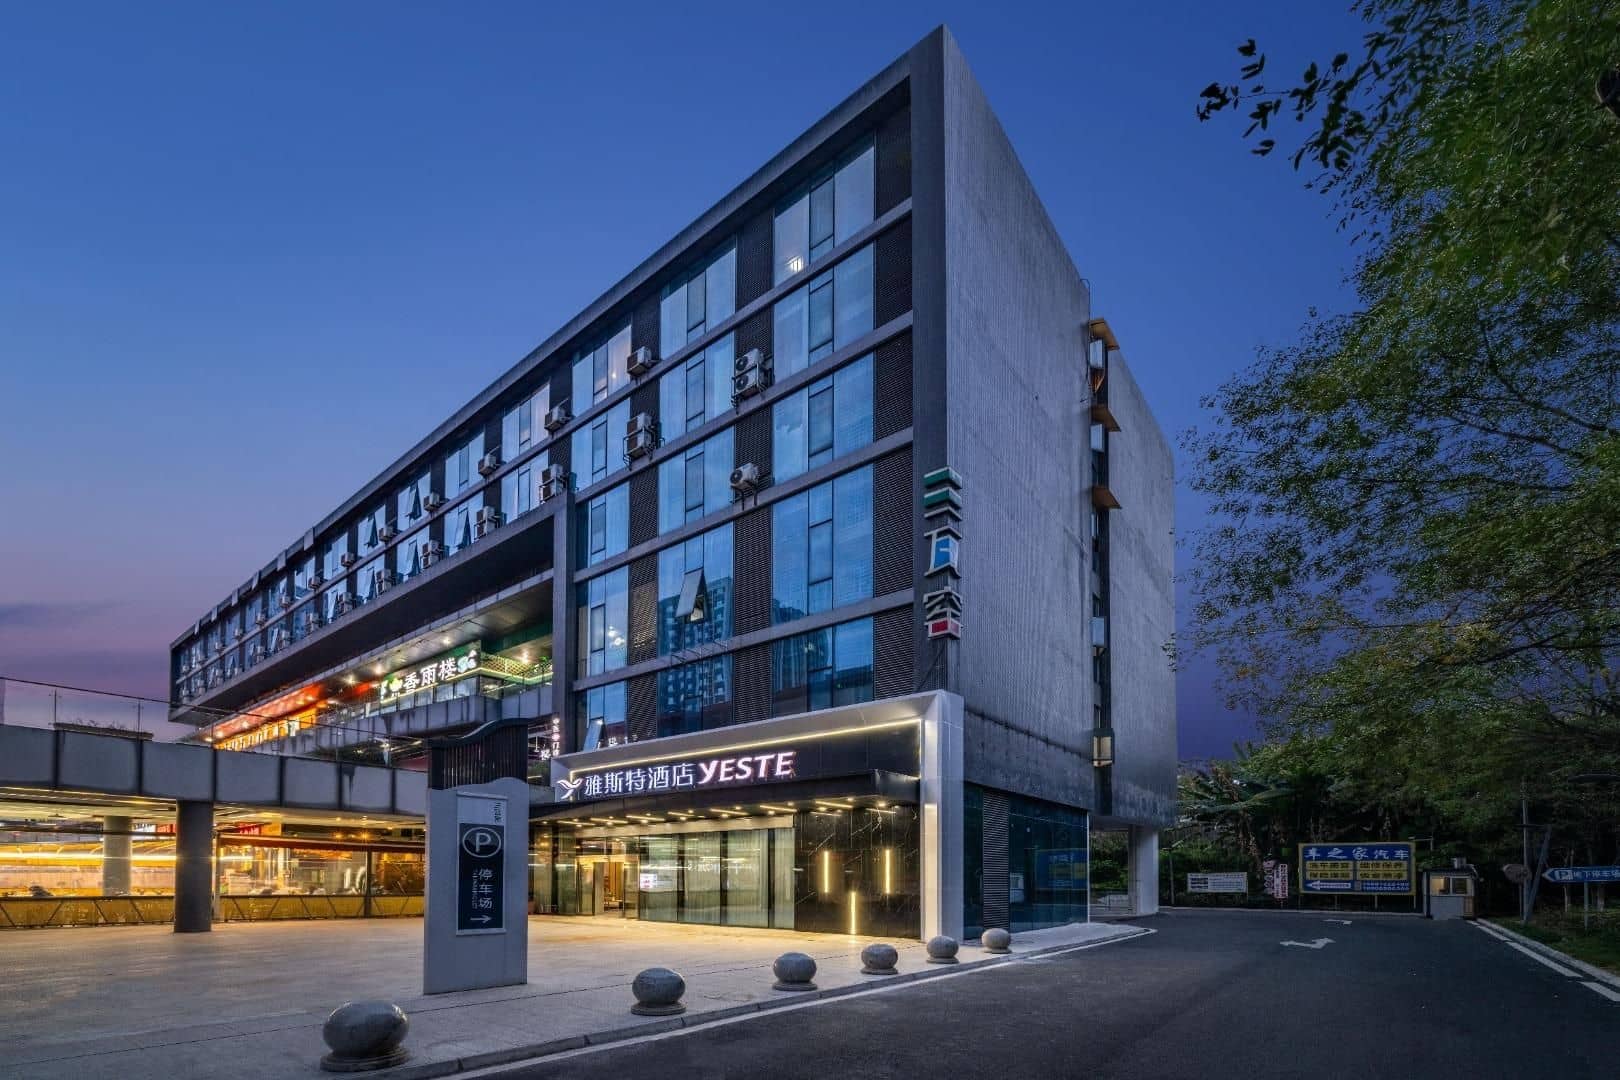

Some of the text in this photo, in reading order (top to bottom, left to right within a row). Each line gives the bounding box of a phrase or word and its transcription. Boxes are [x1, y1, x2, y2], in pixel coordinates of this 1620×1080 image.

[584, 751, 796, 797] 雅斯特酒店 YESTE
[475, 832, 492, 853] P
[478, 868, 493, 909] 停车场
